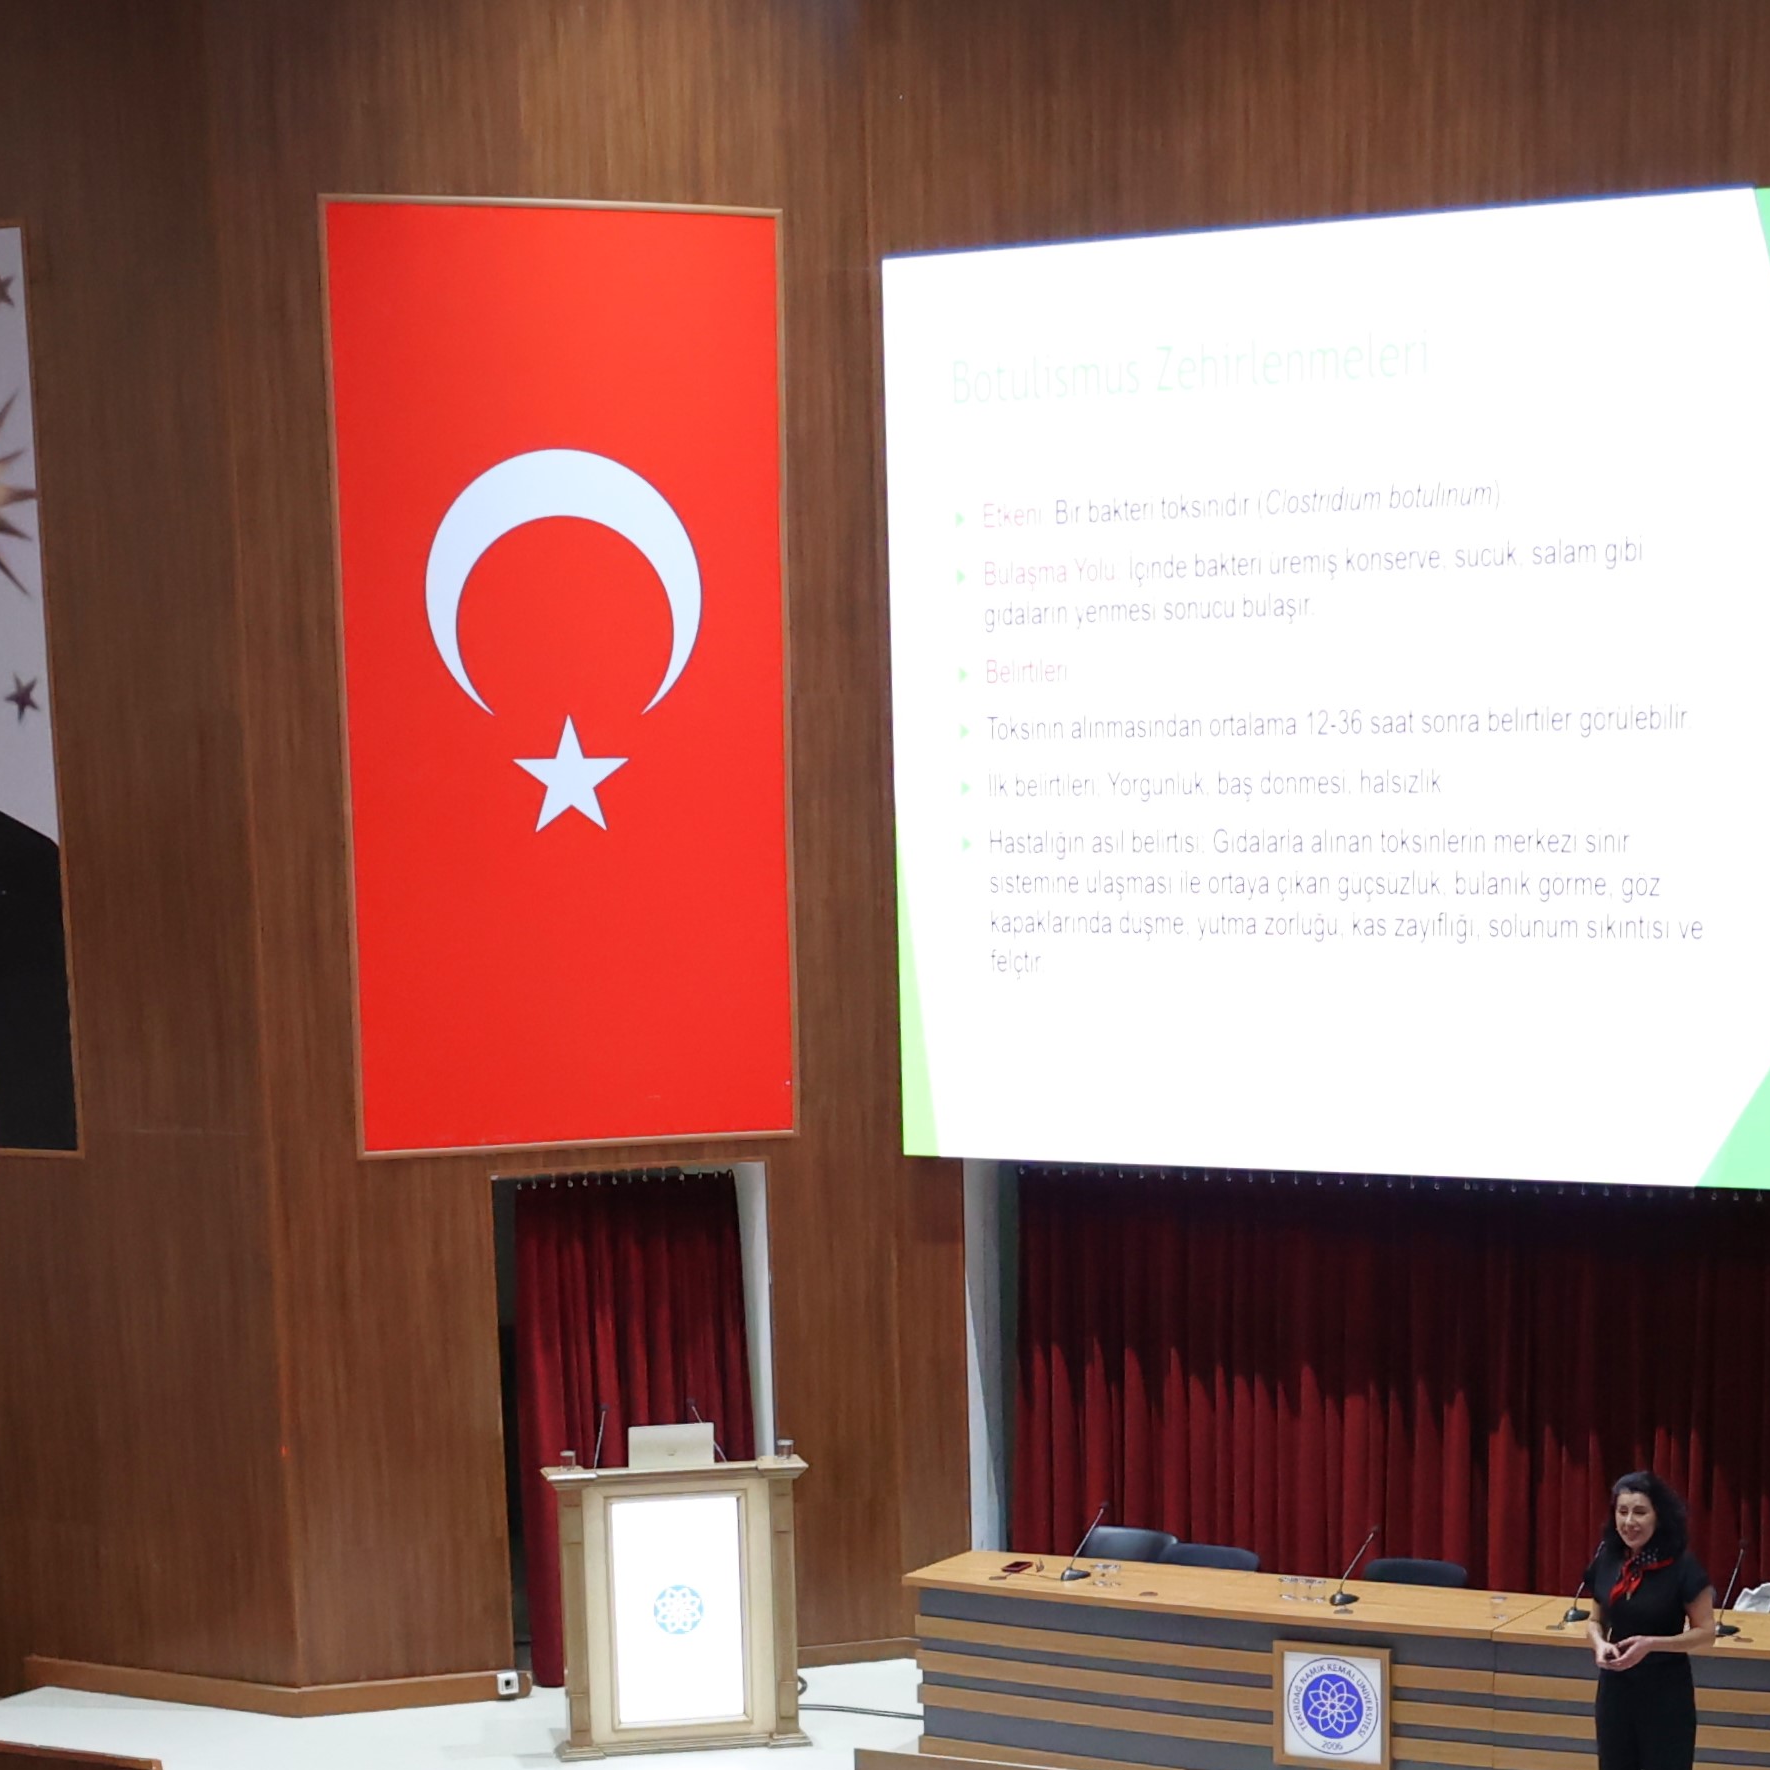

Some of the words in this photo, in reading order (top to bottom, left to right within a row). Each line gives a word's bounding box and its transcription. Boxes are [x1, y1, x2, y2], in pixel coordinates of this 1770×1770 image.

[1532, 539, 1597, 565] salam
[1163, 598, 1235, 620] sonucu
[1210, 712, 1296, 737] ortalama
[1307, 708, 1363, 736] 12-36
[1370, 710, 1413, 735] saat
[1421, 710, 1479, 734] sonra
[1217, 771, 1253, 802] baş
[1208, 872, 1269, 901] ortaya
[1198, 912, 1257, 941] yutma
[1352, 912, 1386, 938] kas
[1488, 913, 1578, 938] solunum
[1678, 918, 1703, 941] ve
